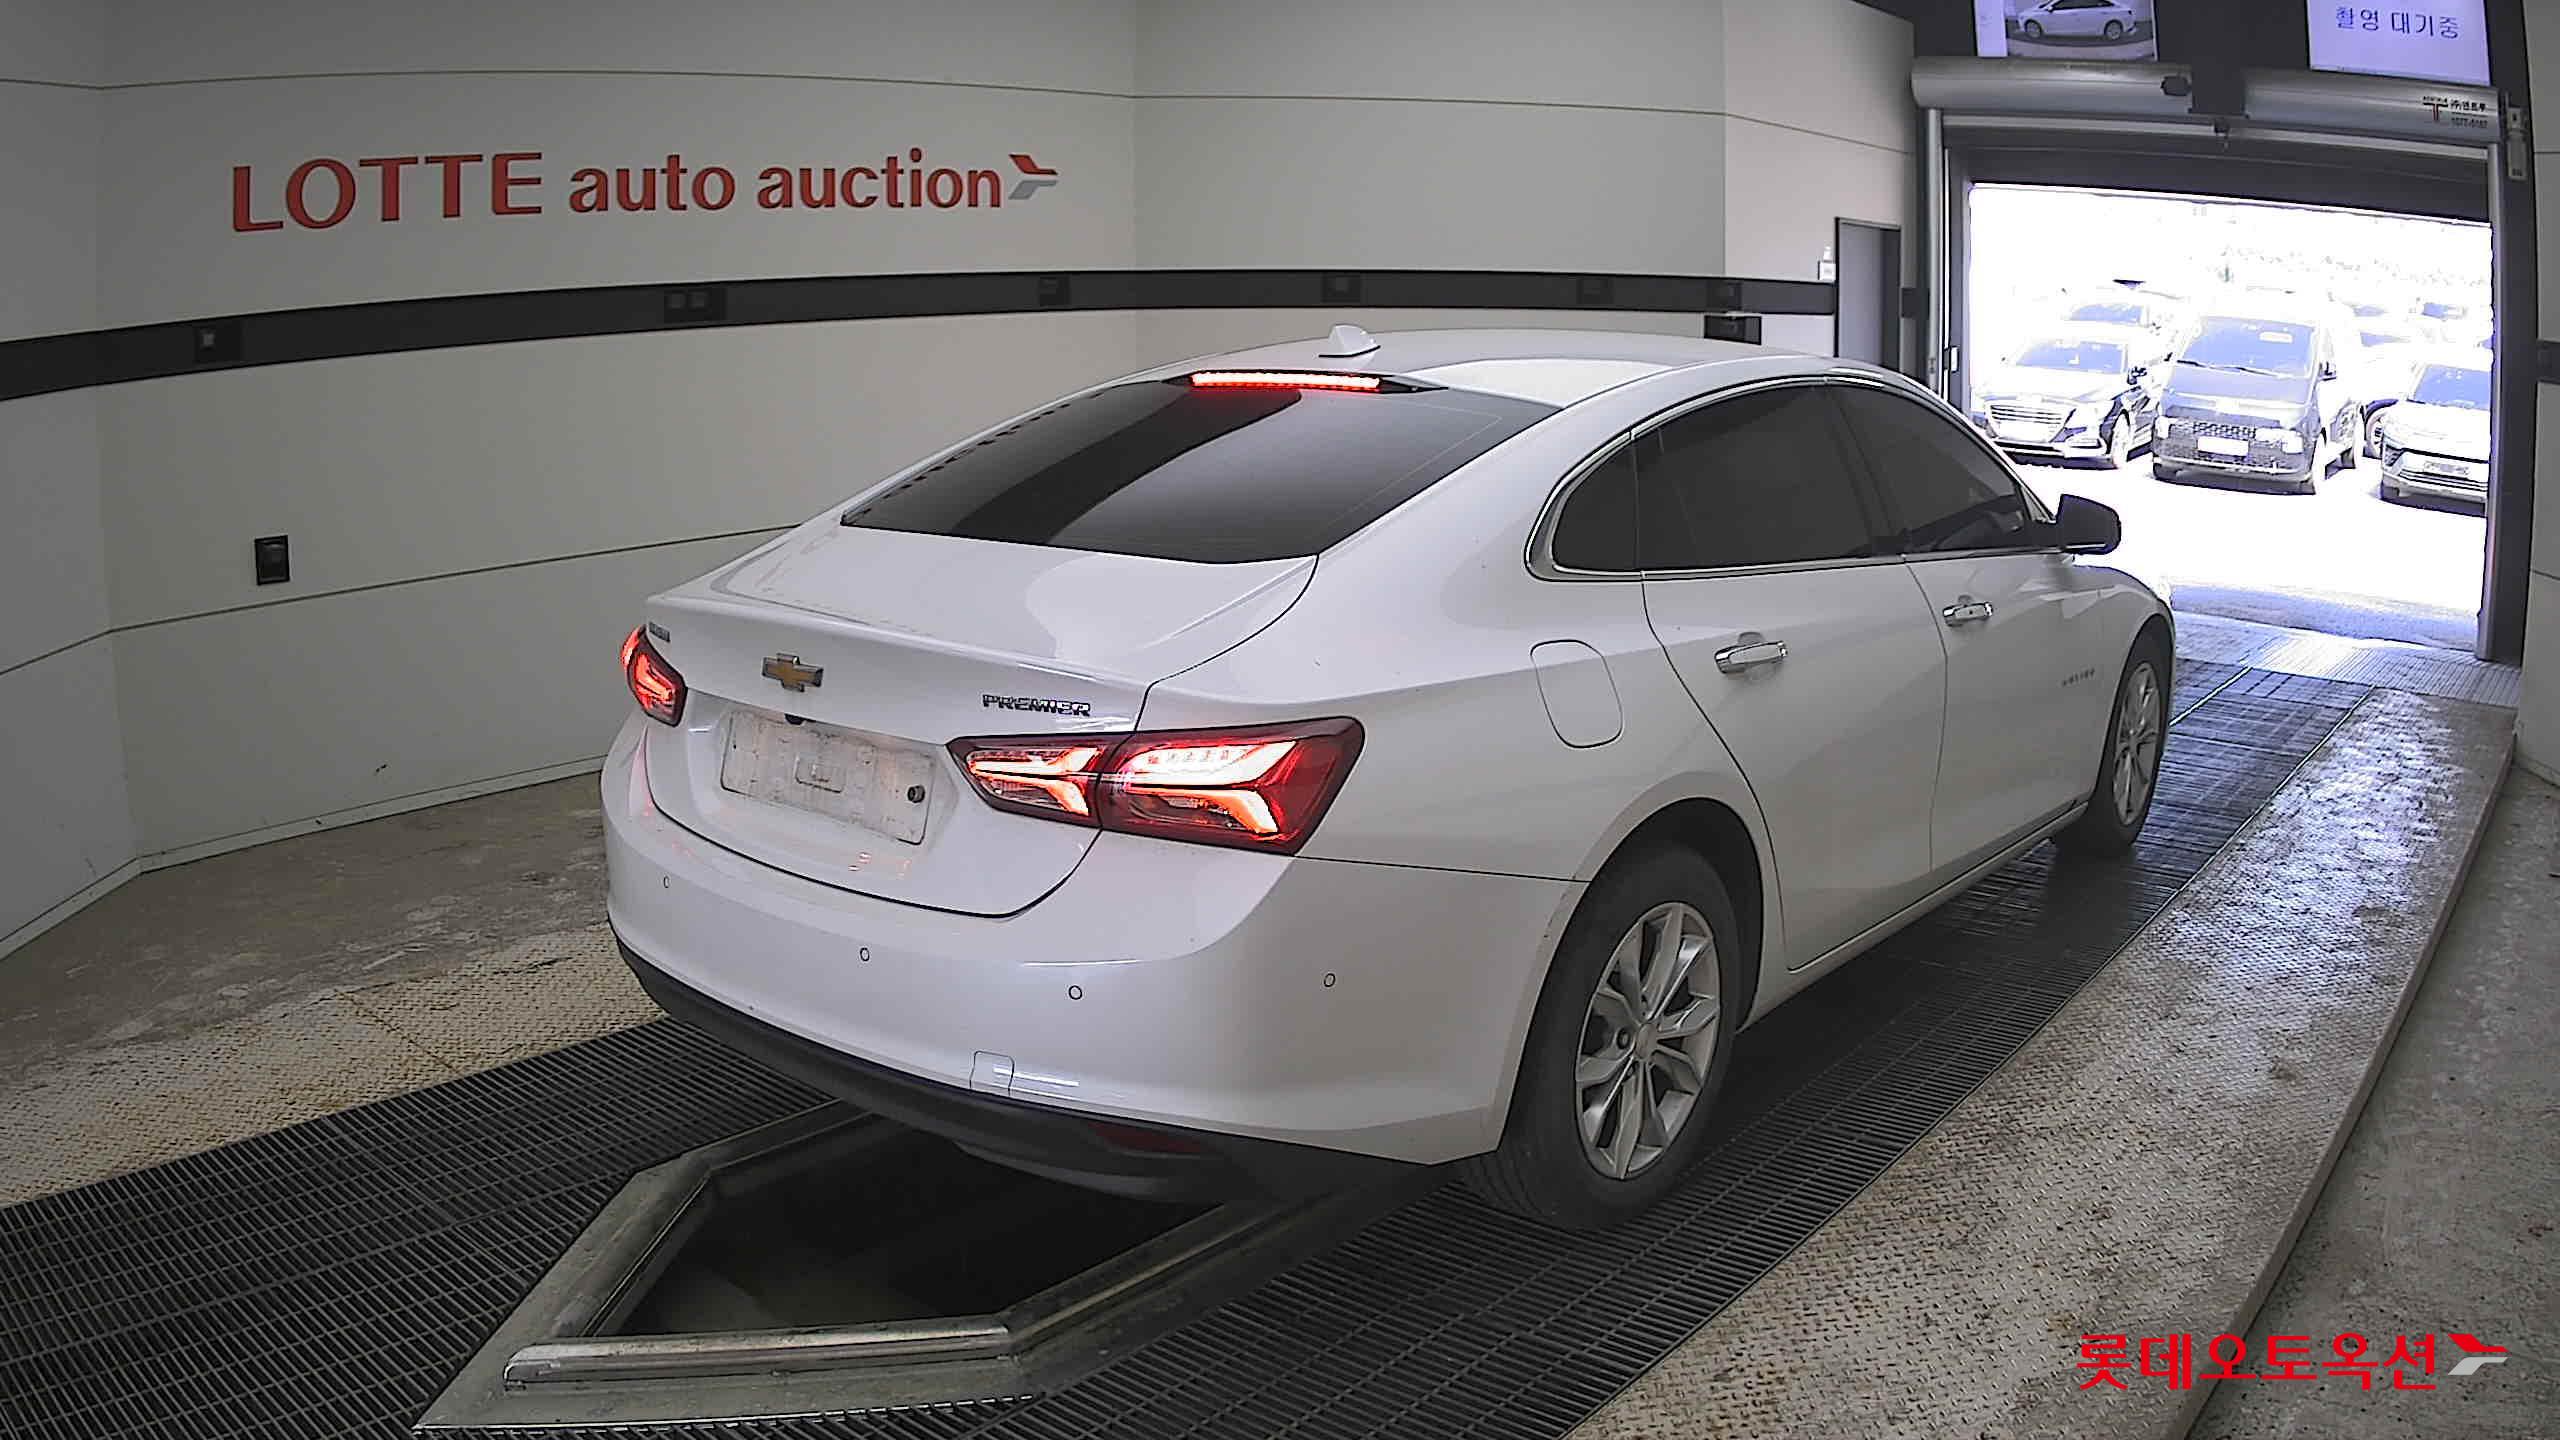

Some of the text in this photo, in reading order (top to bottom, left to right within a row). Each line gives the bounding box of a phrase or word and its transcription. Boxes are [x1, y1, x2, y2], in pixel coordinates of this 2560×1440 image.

[2336, 7, 2458, 39] 촬영 대기중
[232, 147, 1001, 232] LOTTE auto auction
[982, 694, 1091, 717] PREMIER
